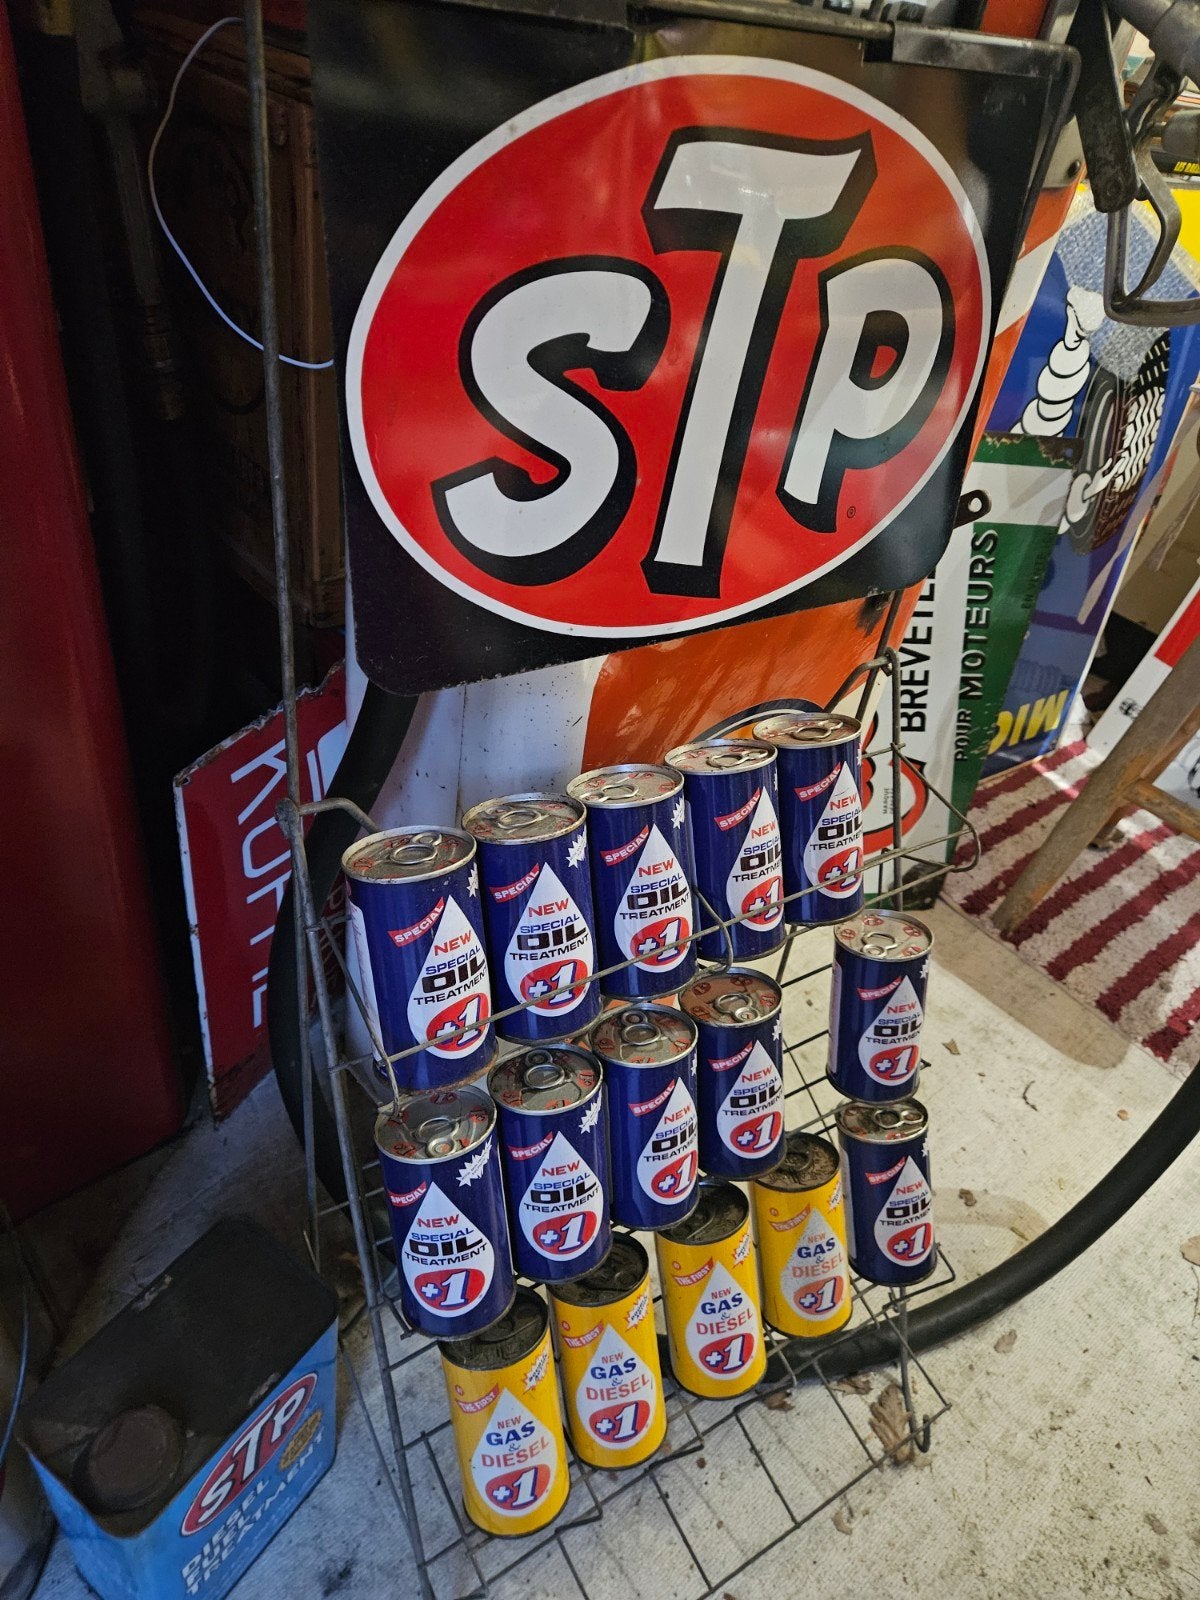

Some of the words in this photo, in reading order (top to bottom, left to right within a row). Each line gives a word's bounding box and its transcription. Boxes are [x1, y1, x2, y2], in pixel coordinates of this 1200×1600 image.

[430, 129, 956, 599] STP
[960, 529, 999, 699] MOTEURS
[954, 708, 973, 763] POUR
[800, 767, 842, 798] SPECIAL
[720, 794, 760, 827] SPECIAL
[830, 794, 857, 810] NEW
[752, 820, 777, 839] NEW
[818, 817, 862, 841] OIL
[605, 830, 649, 863] SPECIAL
[639, 858, 674, 877] NEW
[825, 849, 861, 889] +1
[494, 870, 539, 899] SPECIAL
[627, 883, 687, 910] OIL
[631, 873, 683, 894] SPECIAL
[528, 899, 569, 917] NEW
[620, 893, 690, 920] TREATMENT
[749, 878, 781, 921] +1
[394, 903, 444, 943] SPECIAL
[520, 914, 580, 934] SPECIAL
[433, 930, 472, 956] NEW
[510, 934, 589, 961] TREATMENT
[517, 923, 586, 951] OIL
[638, 918, 681, 962] +1
[425, 946, 481, 975] SPECIAL
[422, 959, 485, 993] OIL
[528, 962, 576, 1006] +1
[860, 980, 901, 999] SPECIAL
[878, 1012, 920, 1025] SPECIAL
[887, 1001, 917, 1014] NEW
[874, 1021, 922, 1037] OIL
[713, 1044, 752, 1070] SPECIAL
[875, 1047, 914, 1078] +1
[734, 1076, 779, 1096] SPECIAL
[742, 1065, 772, 1083] NEW
[633, 1084, 675, 1115] SPECIAL
[730, 1085, 782, 1109] OIL
[664, 1104, 692, 1124] NEW
[652, 1121, 696, 1153] OIL
[737, 1114, 775, 1150] +1
[512, 1136, 553, 1158] SPECIAL
[534, 1172, 591, 1189] SPECIAL
[542, 1160, 581, 1177] NEW
[658, 1153, 695, 1194] +1
[869, 1161, 905, 1184] SPECIAL
[391, 1186, 427, 1205] SPECIAL
[524, 1186, 600, 1212] TREATMENT
[530, 1181, 596, 1204] OIL
[889, 1190, 928, 1206] SPECIAL
[896, 1180, 923, 1195] NEW
[417, 1214, 459, 1228] NEW
[887, 1198, 930, 1219] OIL
[411, 1227, 474, 1241] SPECIAL
[539, 1213, 586, 1250] +1
[807, 1233, 826, 1243] NEW
[894, 1224, 927, 1257] +1
[405, 1243, 487, 1265] TREATMENT
[409, 1237, 483, 1256] OIL
[796, 1238, 835, 1259] GAS
[792, 1252, 843, 1278] DIESEL
[815, 1256, 825, 1264] &
[421, 1270, 470, 1308] +1
[711, 1287, 732, 1299] NEW
[799, 1278, 836, 1313] +1
[701, 1293, 743, 1314] GAS
[696, 1308, 753, 1335] DIESEL
[602, 1352, 624, 1364] NEW
[705, 1335, 744, 1371] +1
[591, 1358, 636, 1379] GAS
[586, 1374, 649, 1401] DIESEL
[611, 1378, 623, 1386] &
[486, 1421, 535, 1445] GAS
[497, 1416, 521, 1429] NEW
[596, 1401, 638, 1441] +1
[198, 1387, 307, 1523] STP
[481, 1437, 549, 1468] DIESEL
[509, 1443, 521, 1452] &
[493, 1467, 538, 1507] +1
[187, 1425, 325, 1595] TREATMENT
[182, 1478, 271, 1579] DIESEL
[186, 1514, 253, 1588] FUEL
